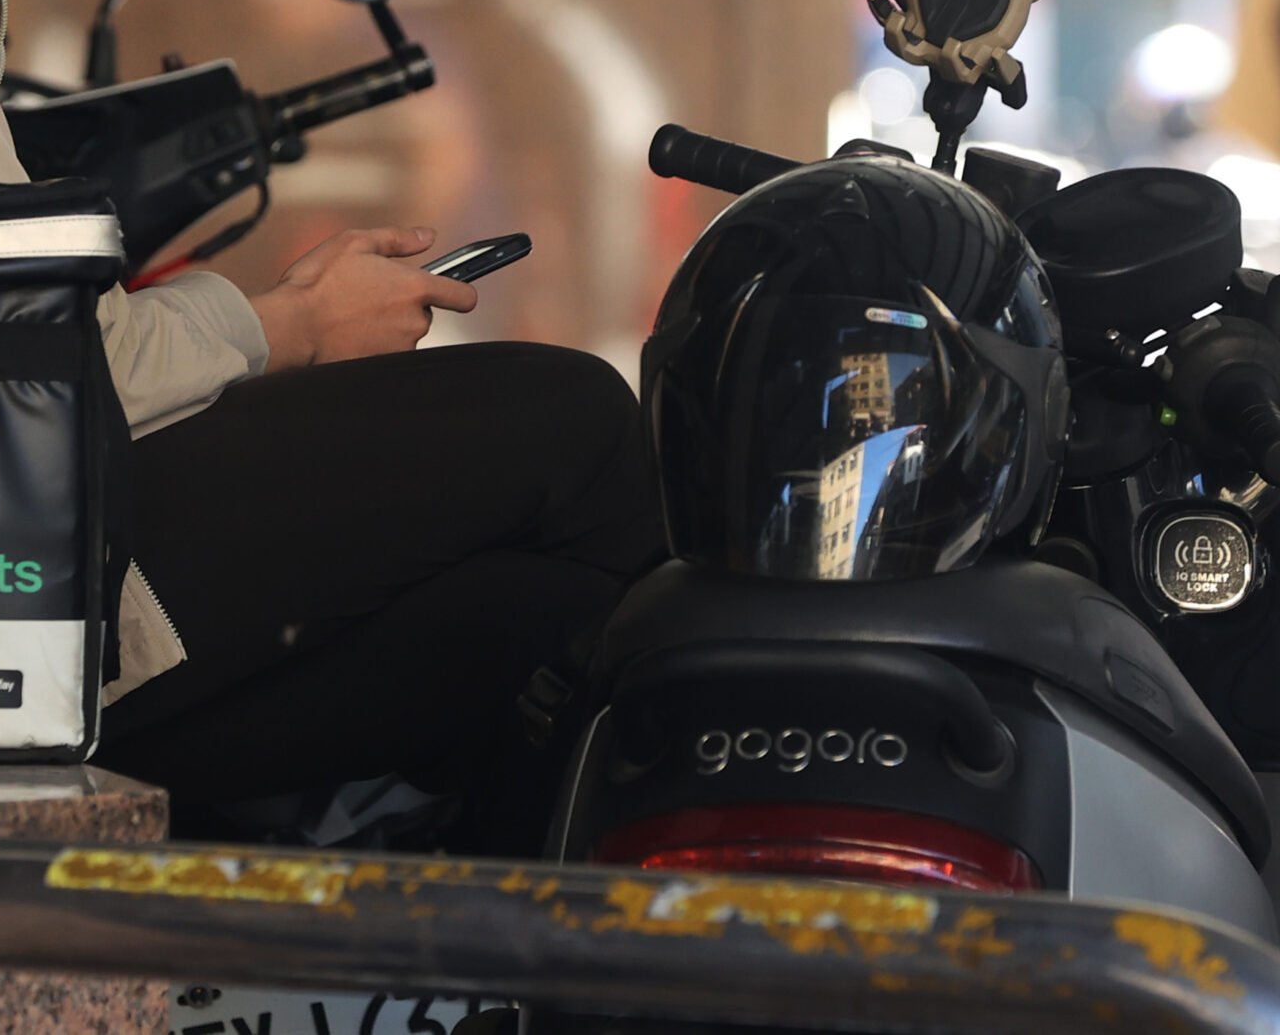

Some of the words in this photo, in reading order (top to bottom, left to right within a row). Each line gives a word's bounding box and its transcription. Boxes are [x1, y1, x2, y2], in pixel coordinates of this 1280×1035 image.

[1190, 572, 1230, 583] SMART
[1186, 582, 1218, 593] LOCK
[696, 727, 908, 775] gogoro
